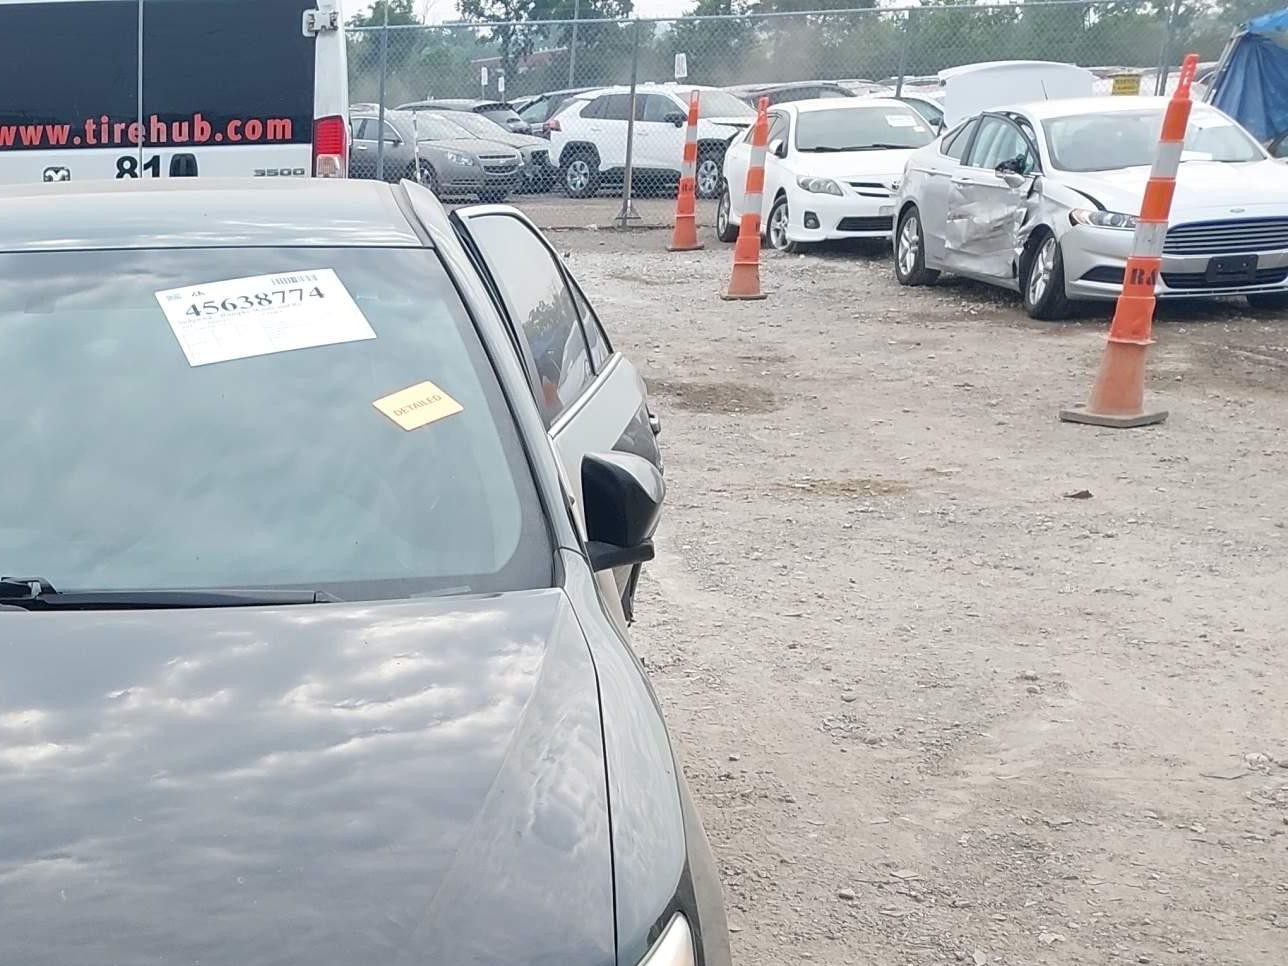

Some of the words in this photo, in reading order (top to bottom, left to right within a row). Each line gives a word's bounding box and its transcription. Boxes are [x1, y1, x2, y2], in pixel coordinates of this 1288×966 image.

[253, 168, 306, 177] 3500
[185, 286, 326, 318] 45638774
[393, 394, 442, 416] DETAILED
